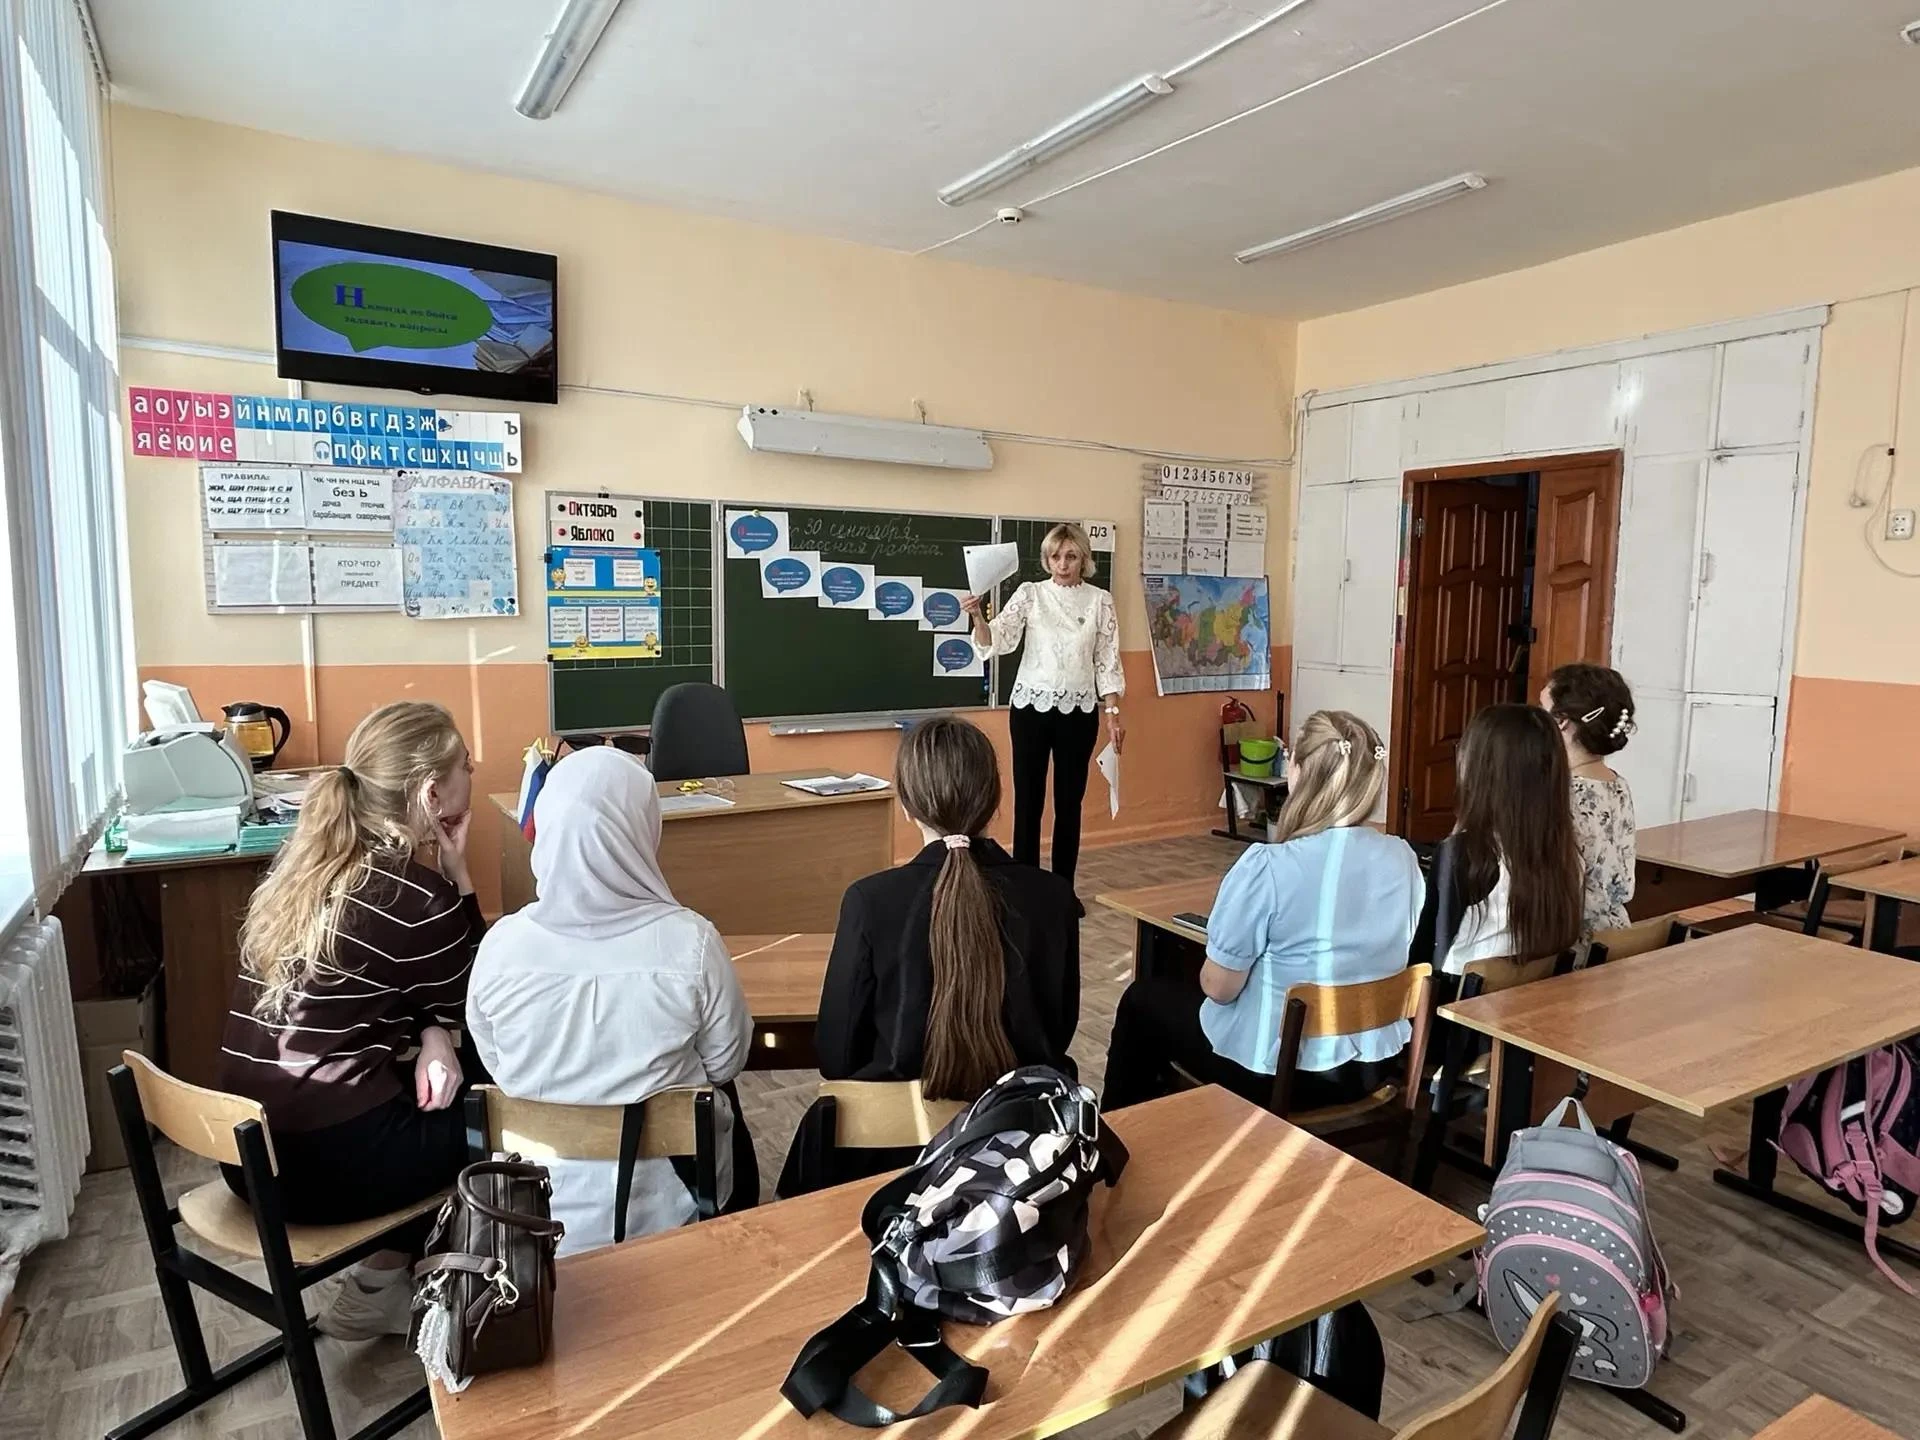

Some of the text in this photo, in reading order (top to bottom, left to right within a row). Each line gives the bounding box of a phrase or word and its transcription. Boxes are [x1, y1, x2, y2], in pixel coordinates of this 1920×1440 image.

[332, 487, 355, 498] без
[804, 518, 823, 535] 30
[1089, 525, 1107, 539] Д/З
